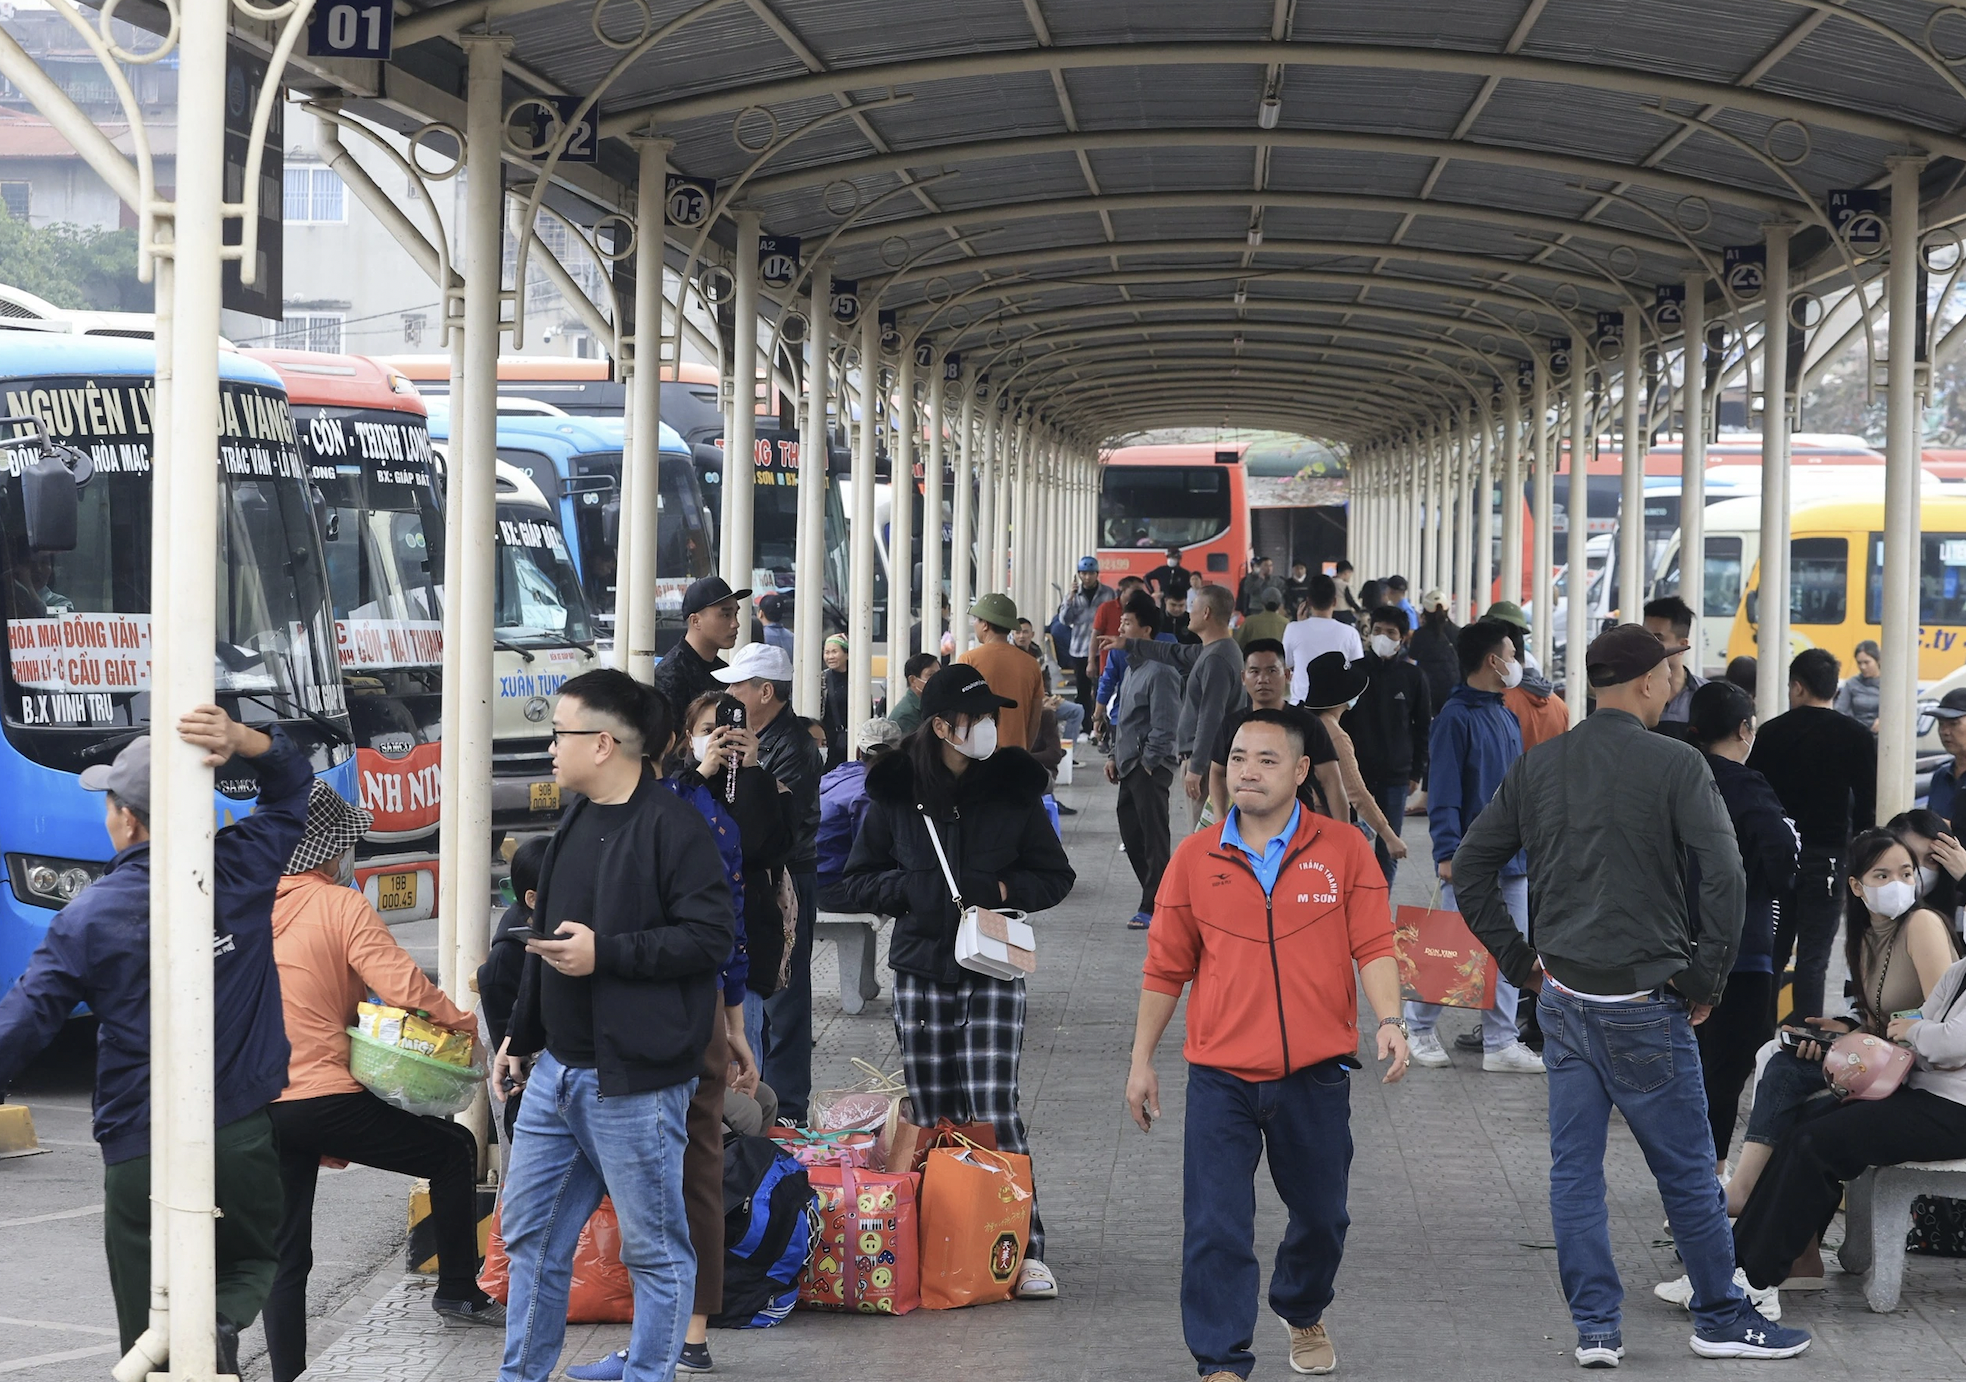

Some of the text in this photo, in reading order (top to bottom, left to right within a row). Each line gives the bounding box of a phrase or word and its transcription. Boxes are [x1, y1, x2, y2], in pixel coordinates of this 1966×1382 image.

[328, 4, 381, 50] 01
[671, 194, 707, 222] 03
[1832, 194, 1848, 205] A1
[1838, 209, 1876, 236] 22
[760, 241, 776, 251] A2
[1726, 249, 1739, 259] A1
[1658, 287, 1670, 297] A1
[6, 380, 127, 438] NGUYÊN
[128, 380, 155, 434] LÝ
[240, 388, 294, 444] VÀNG
[309, 407, 347, 456] CỒN
[354, 421, 404, 466] THỊNH
[400, 425, 433, 464] LONG
[90, 439, 120, 473] HÒA
[119, 443, 150, 477] MẠC
[221, 441, 250, 475] TRÁC
[249, 443, 273, 476] VĂN
[312, 465, 336, 480] ONG
[376, 469, 430, 487] BX: GIÁP BÁT
[499, 520, 522, 546] BX:
[518, 519, 542, 548] GIÁP
[8, 621, 35, 649] HÒA
[63, 614, 107, 649] ĐỒNG
[109, 616, 140, 648] VĂN
[41, 655, 52, 681] LÝ
[68, 651, 101, 686] CẦU
[104, 654, 137, 686] GIÁT
[500, 669, 535, 697] XUÂN
[22, 689, 114, 725] B.X VĨNH TRỤ
[380, 742, 412, 752] SAMCO
[391, 876, 407, 891] 18B
[1324, 868, 1338, 894] THANH
[382, 891, 413, 910] 000.45
[1313, 892, 1337, 903] SƠN
